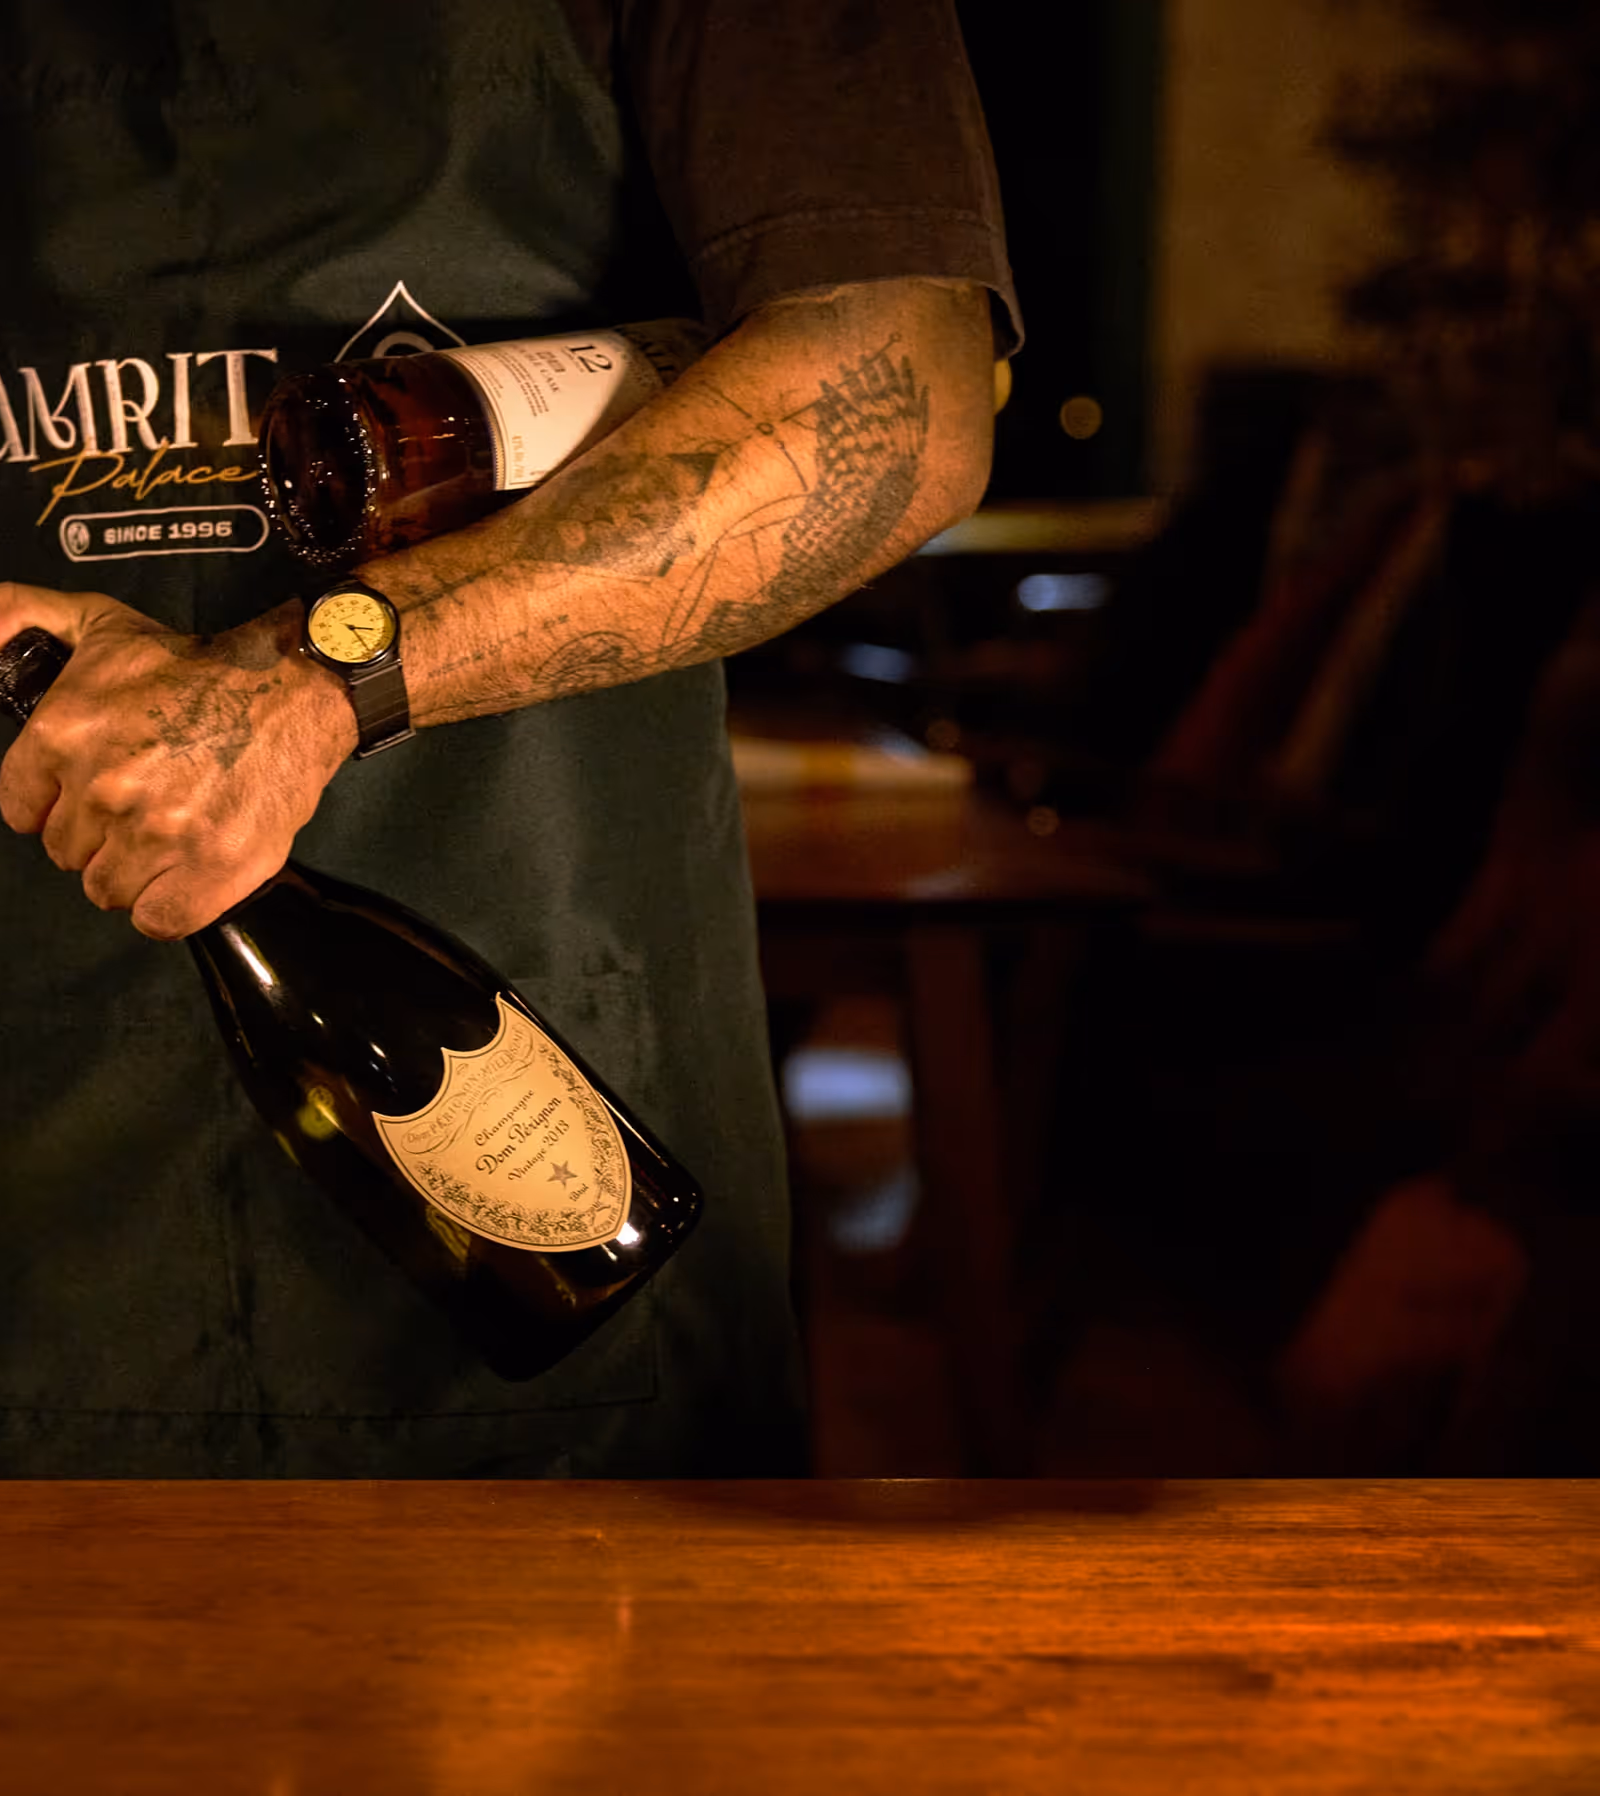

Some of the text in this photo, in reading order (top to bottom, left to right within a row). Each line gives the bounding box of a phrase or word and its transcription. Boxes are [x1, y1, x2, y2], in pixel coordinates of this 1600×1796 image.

[568, 345, 612, 373] 12
[29, 436, 261, 527] Palace
[104, 521, 233, 545] SINCE 1996
[474, 1089, 535, 1147] Champagne
[475, 1096, 562, 1175] Dom Pérignon
[507, 1119, 570, 1181] Vintage 2013
